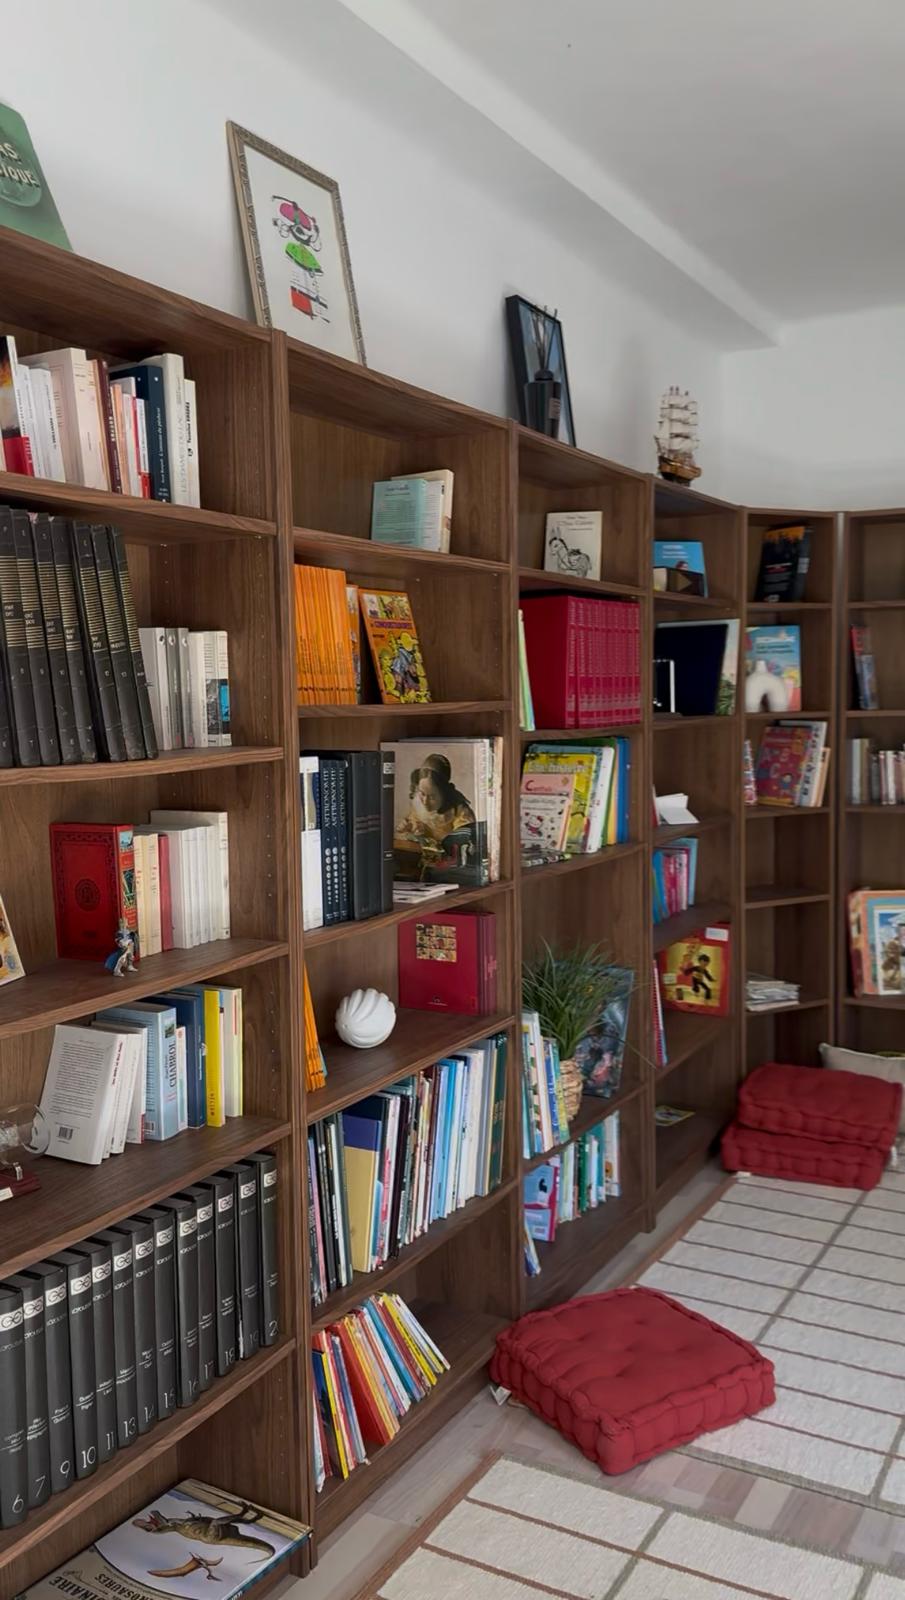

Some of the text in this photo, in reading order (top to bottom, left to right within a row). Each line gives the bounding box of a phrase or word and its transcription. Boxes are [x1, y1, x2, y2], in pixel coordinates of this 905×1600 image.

[169, 1041, 177, 1087] CHABROL
[123, 1417, 136, 1438] 13
[106, 1431, 115, 1451] 11
[82, 1446, 97, 1469] 10
[60, 1460, 71, 1478] 9
[35, 1475, 46, 1498] 7
[12, 1493, 24, 1514] 6
